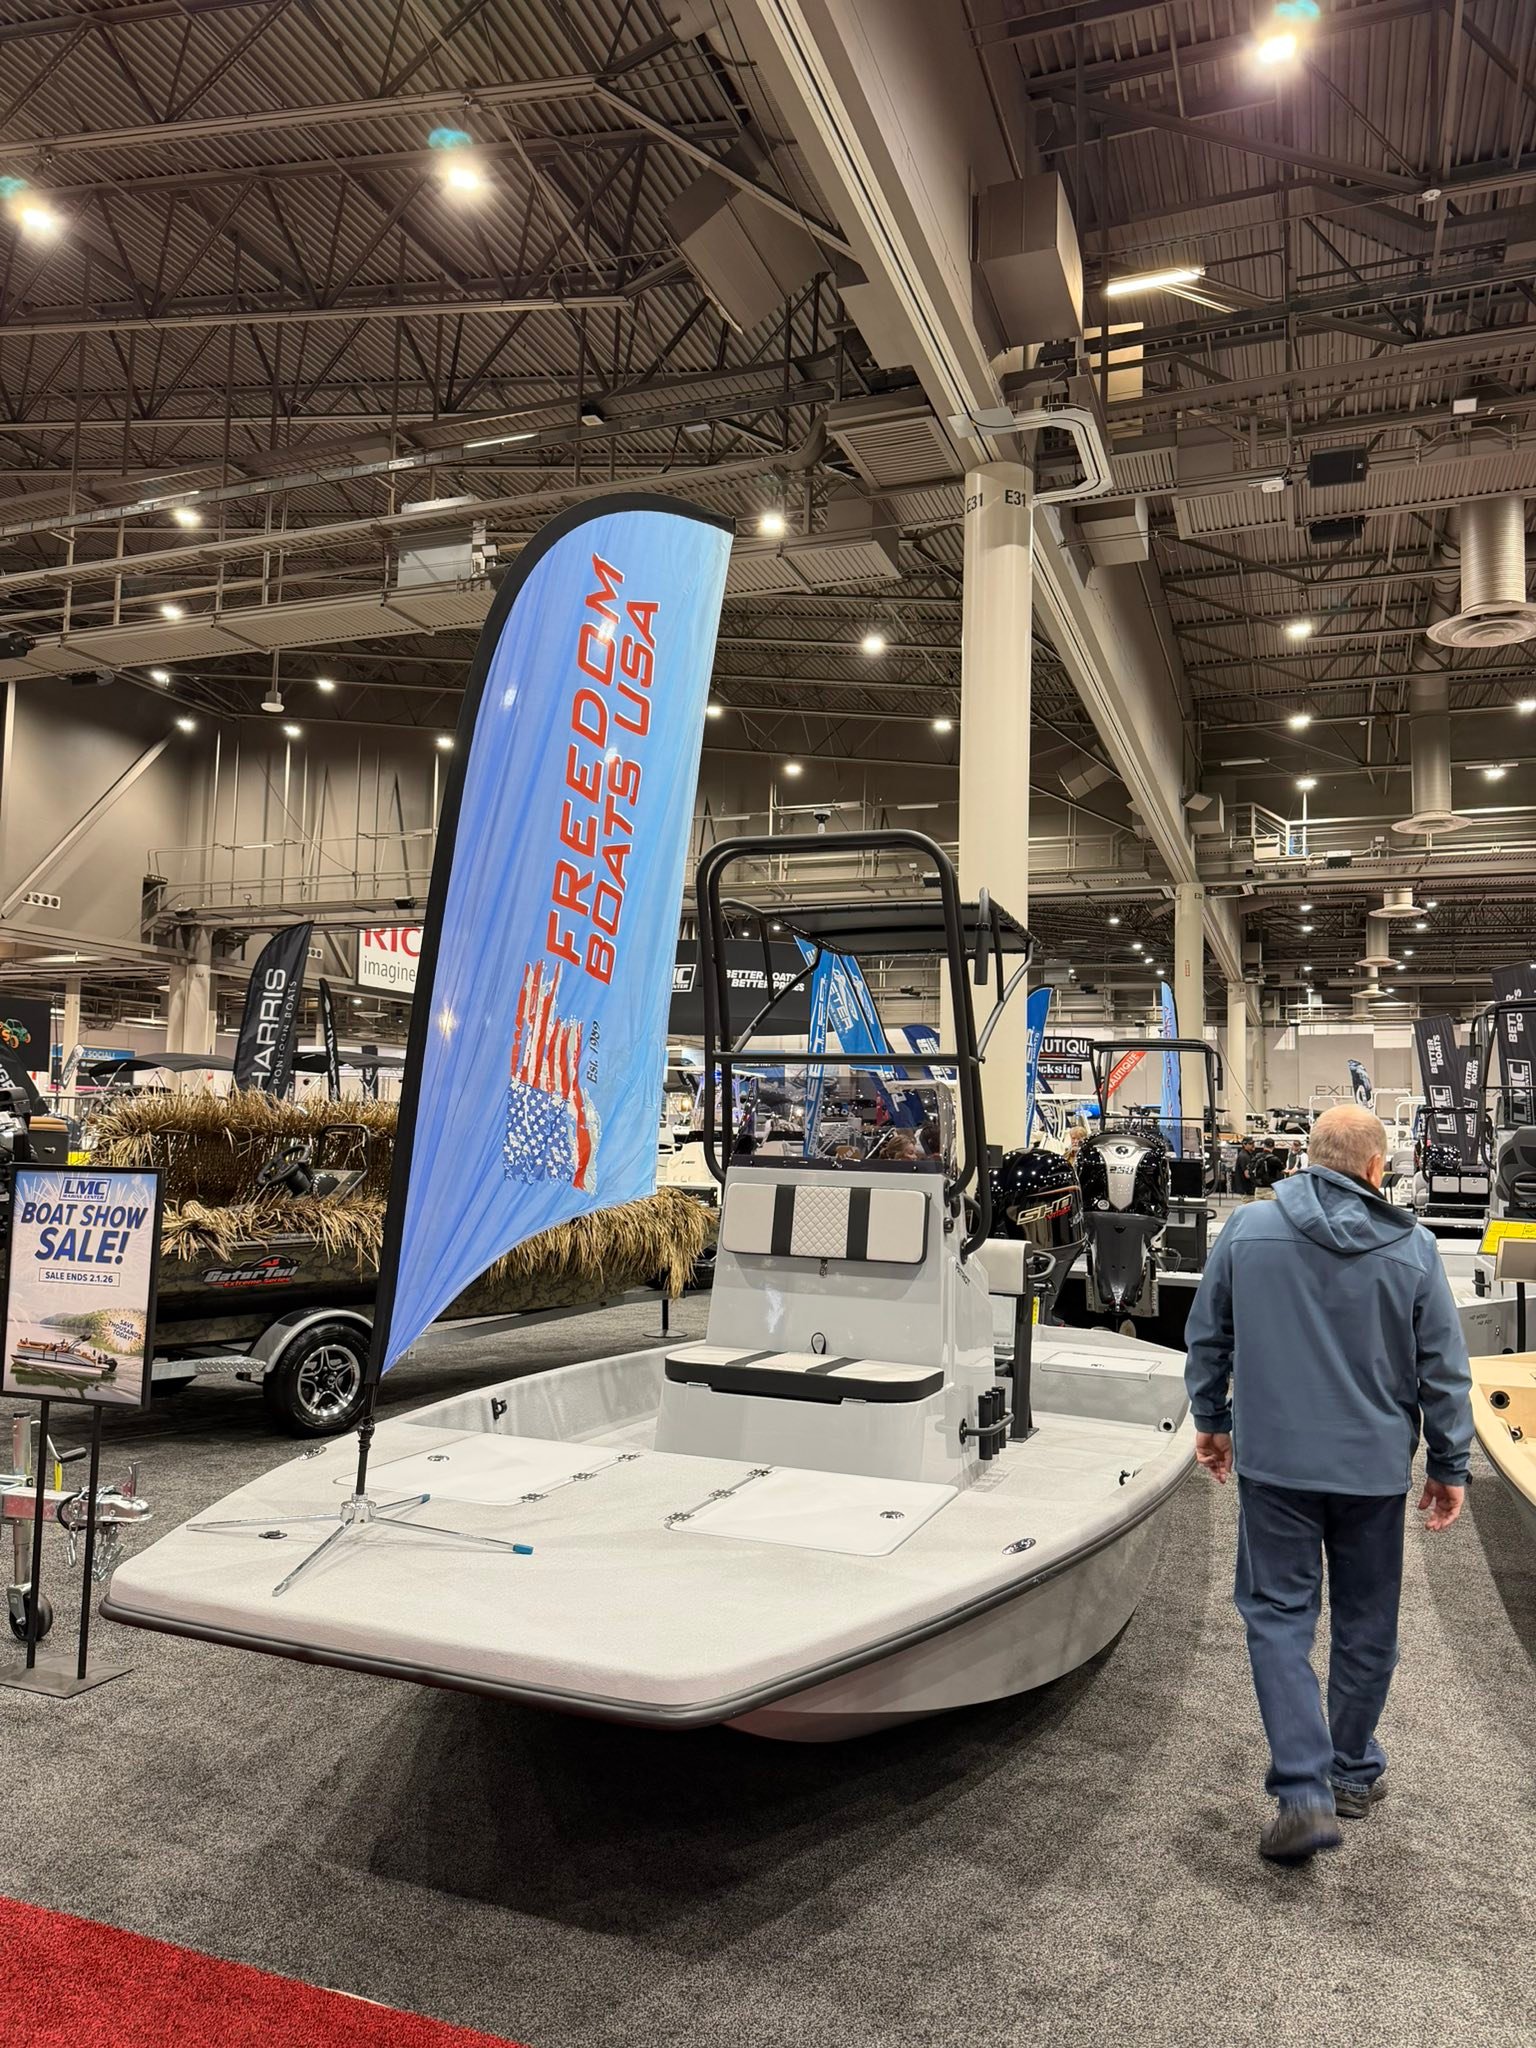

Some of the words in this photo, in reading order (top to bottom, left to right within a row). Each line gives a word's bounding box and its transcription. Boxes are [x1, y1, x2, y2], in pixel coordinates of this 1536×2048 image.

[966, 492, 983, 514] E31
[1005, 489, 1026, 507] E31
[546, 552, 626, 967] FREEDOM
[584, 754, 643, 985] BOATS
[614, 600, 660, 737] USA
[364, 955, 416, 983] imagine
[726, 969, 764, 979] BETTER
[766, 972, 797, 982] OATS
[251, 968, 286, 1089] HARRIS
[1506, 994, 1518, 1043] BETTR
[273, 1024, 290, 1085] PONTOON
[284, 981, 297, 1019] BOATS
[588, 1020, 600, 1056] 1989
[1427, 1038, 1438, 1074] BETTER
[1433, 1034, 1444, 1066] BOATS
[586, 1057, 598, 1085] Est.
[1464, 1061, 1473, 1090] BETTER
[1471, 1059, 1479, 1085] BOATS
[64, 1180, 108, 1195] LMC
[21, 1202, 78, 1226] BOAT
[80, 1205, 148, 1229] SHOW
[35, 1227, 130, 1265] SALE!
[45, 1271, 64, 1281] SALE
[66, 1273, 88, 1282] ENDS
[89, 1274, 113, 1283] 2.1.26
[109, 1320, 142, 1339] THOUSANDS
[120, 1319, 134, 1329] SAVE
